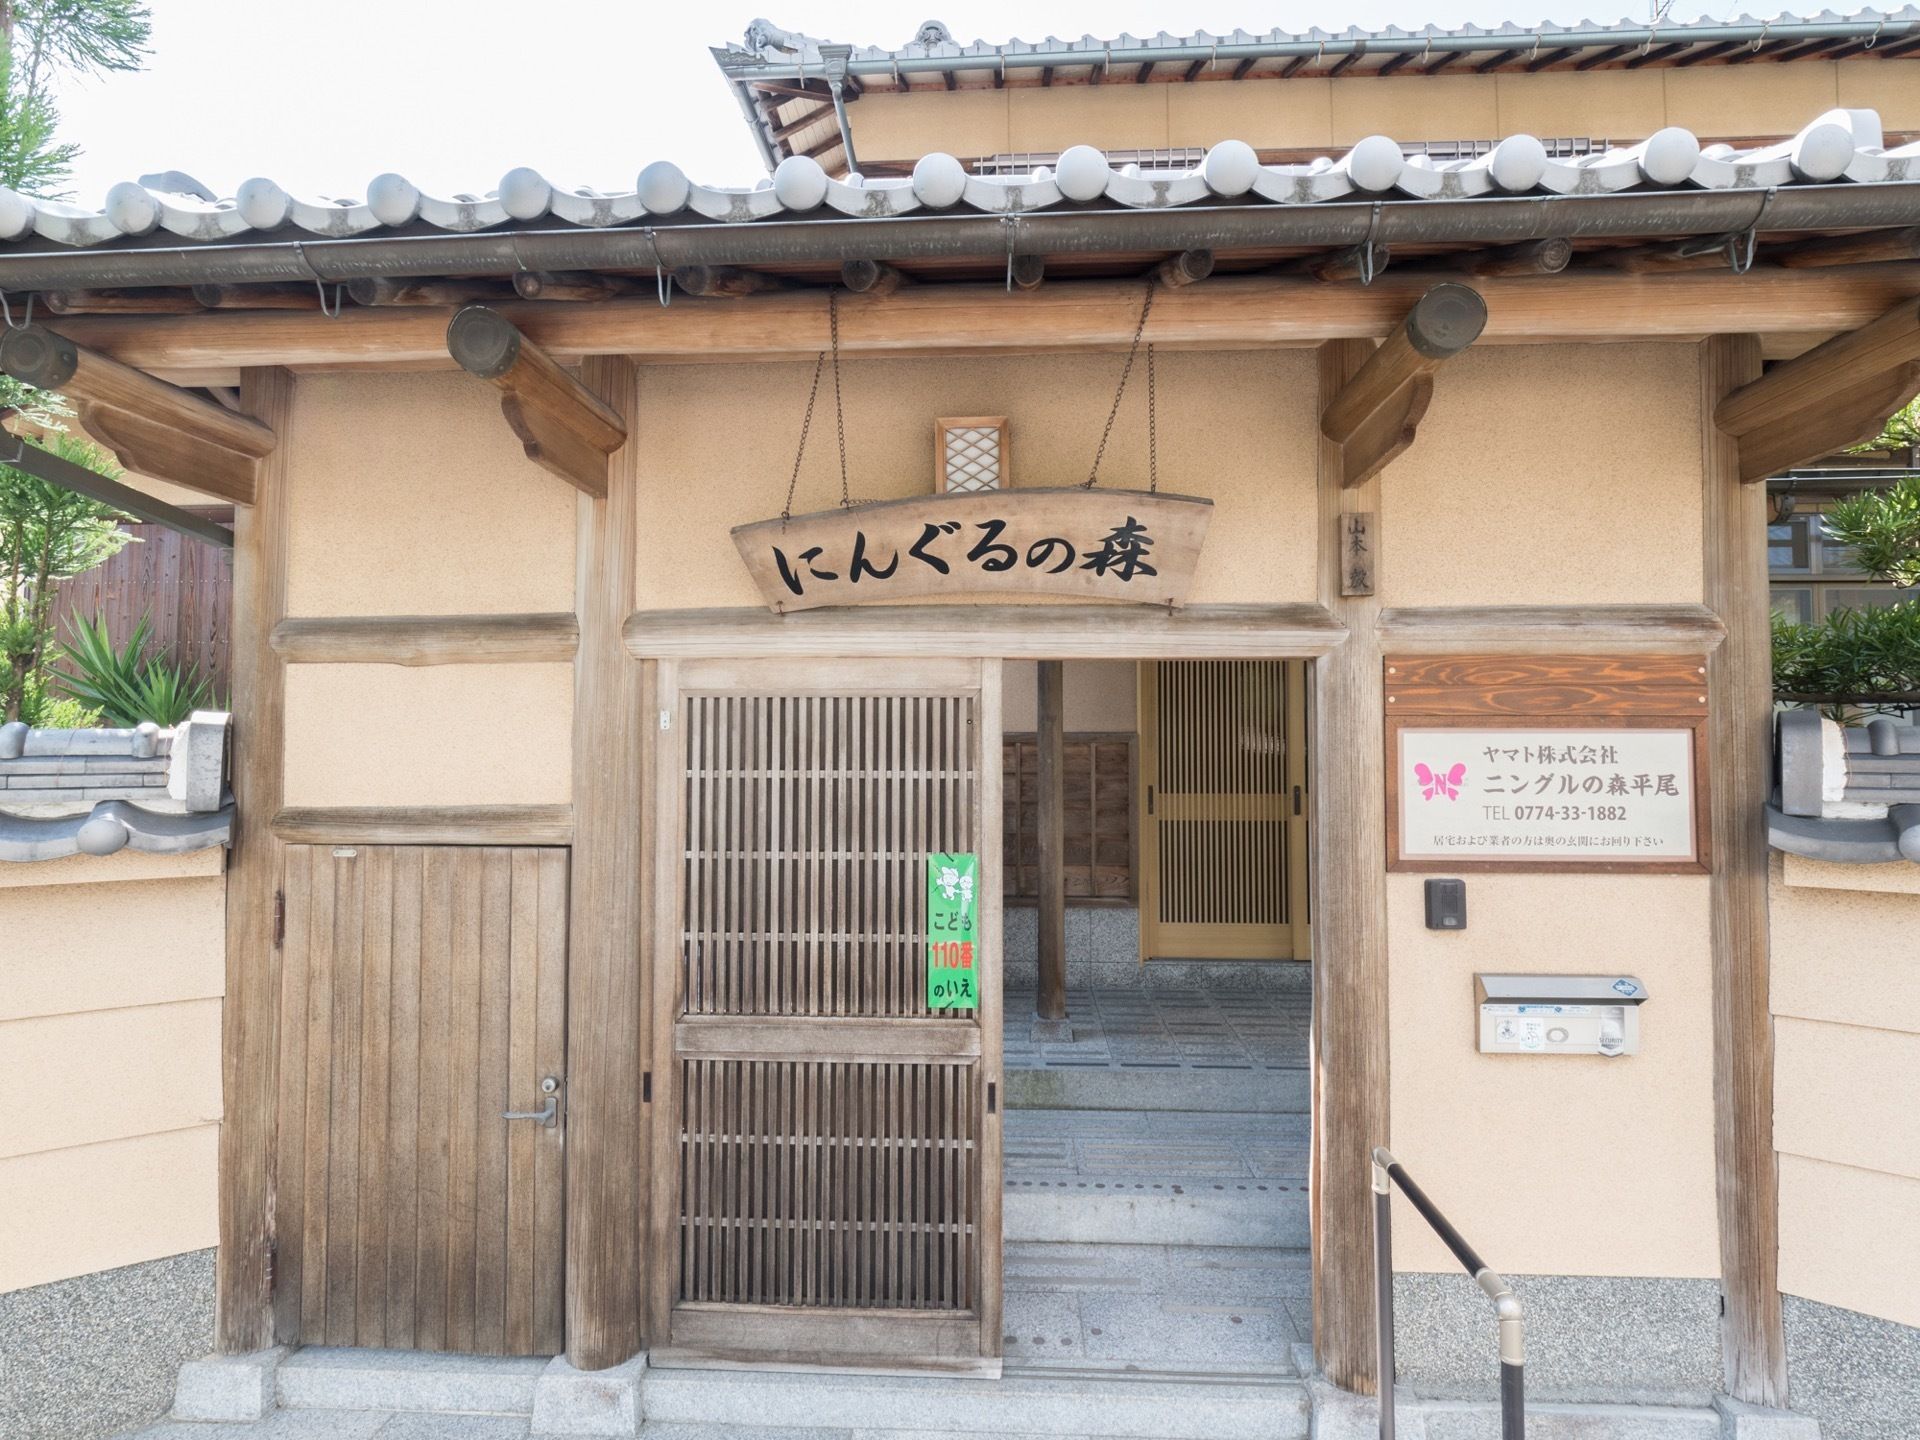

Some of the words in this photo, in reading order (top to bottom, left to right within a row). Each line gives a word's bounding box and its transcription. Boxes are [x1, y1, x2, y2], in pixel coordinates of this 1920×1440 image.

[771, 516, 1158, 596] にんぐるの森
[1482, 745, 1619, 765] ヤマト株式会社
[1482, 773, 1681, 797] ニングルの森平尾
[1482, 805, 1511, 821] TEL
[1514, 805, 1628, 821] 0774-33-1882
[1433, 834, 1665, 848] 居宅および業者の方は奥の玄関にお回り下さい
[934, 911, 973, 931] こども
[932, 941, 974, 969] 110番
[933, 978, 973, 998] のいえ
